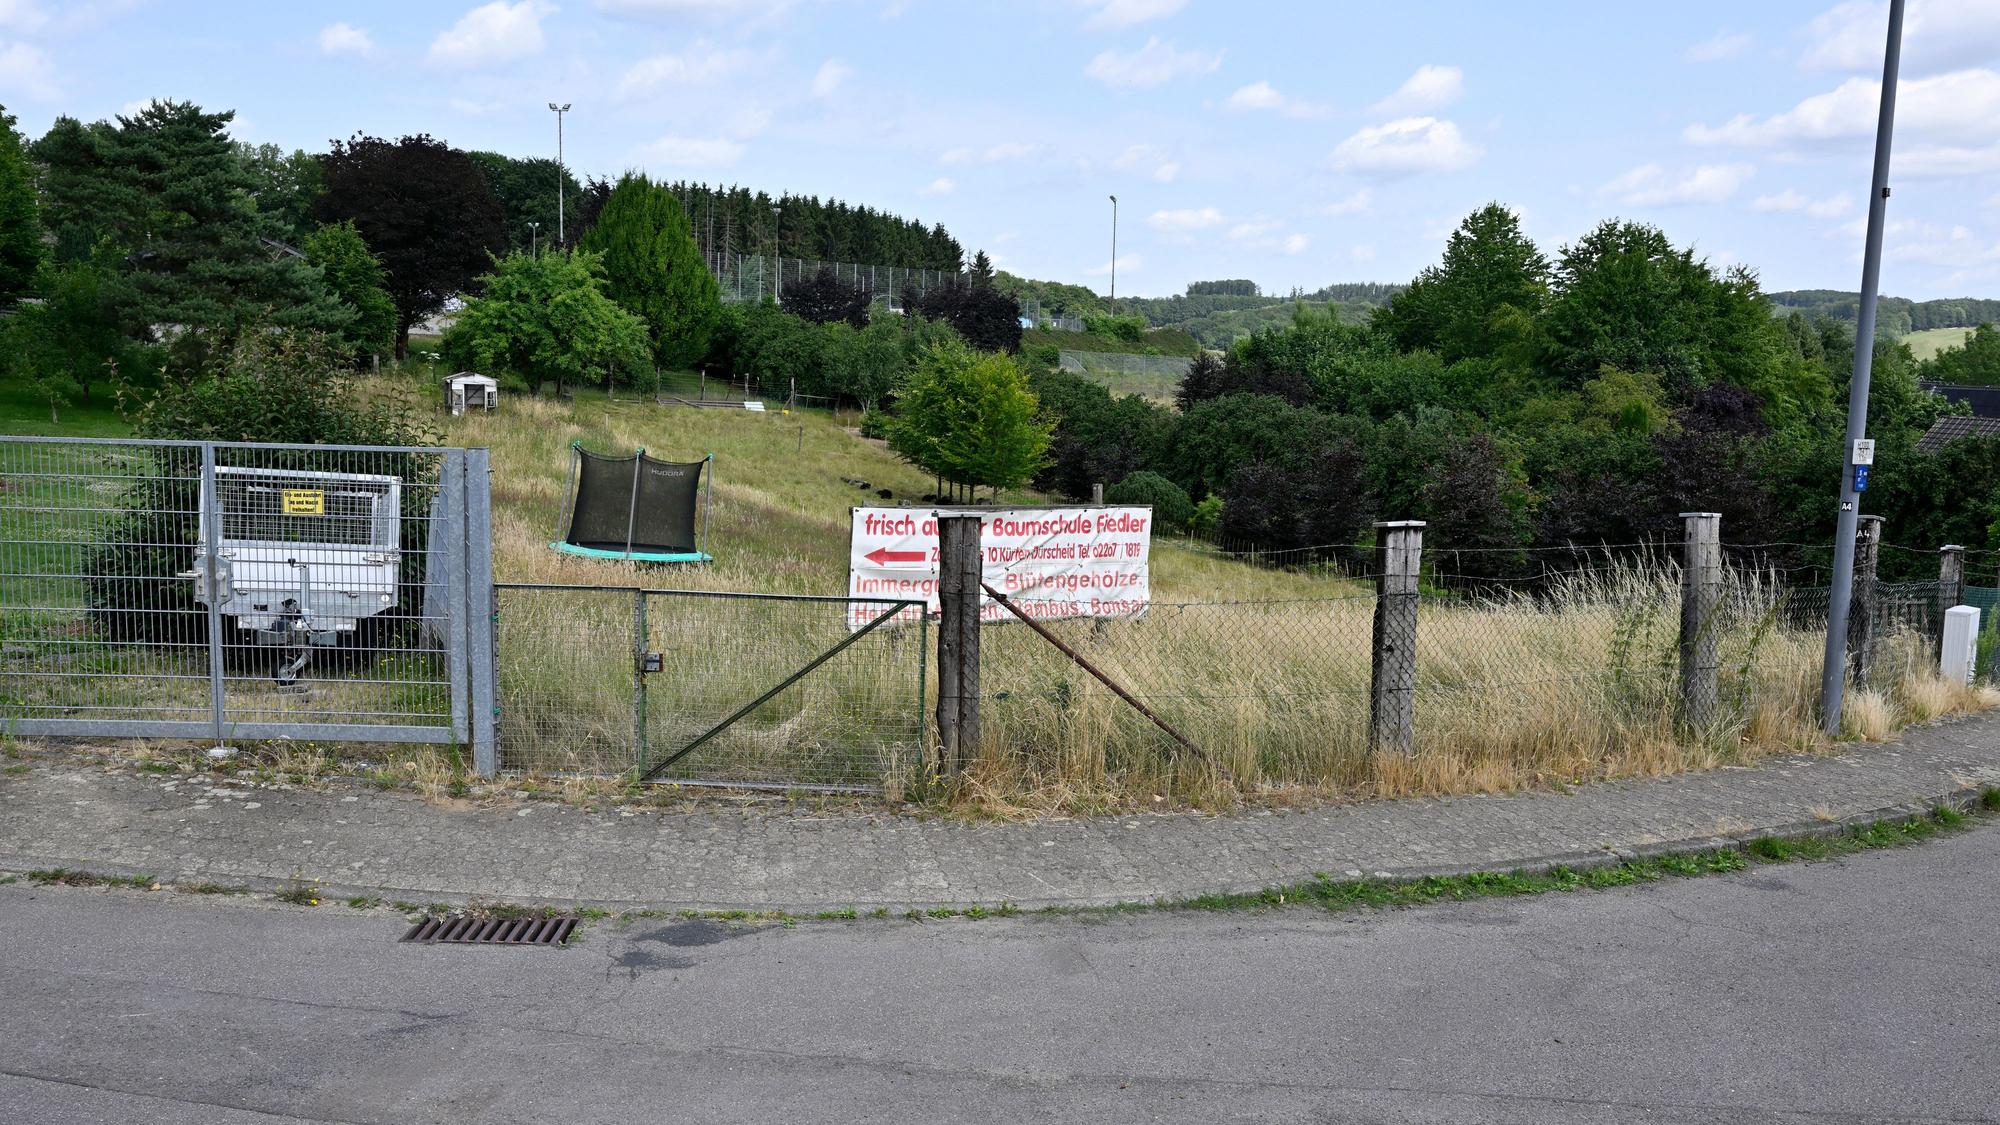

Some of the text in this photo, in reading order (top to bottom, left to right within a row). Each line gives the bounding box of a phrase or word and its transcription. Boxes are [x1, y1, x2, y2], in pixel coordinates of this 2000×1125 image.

[1841, 502, 1852, 511] A4
[866, 513, 916, 536] frisch
[993, 514, 1092, 537] Baumschule
[1096, 512, 1147, 533] Fiedler
[988, 546, 998, 562] 10
